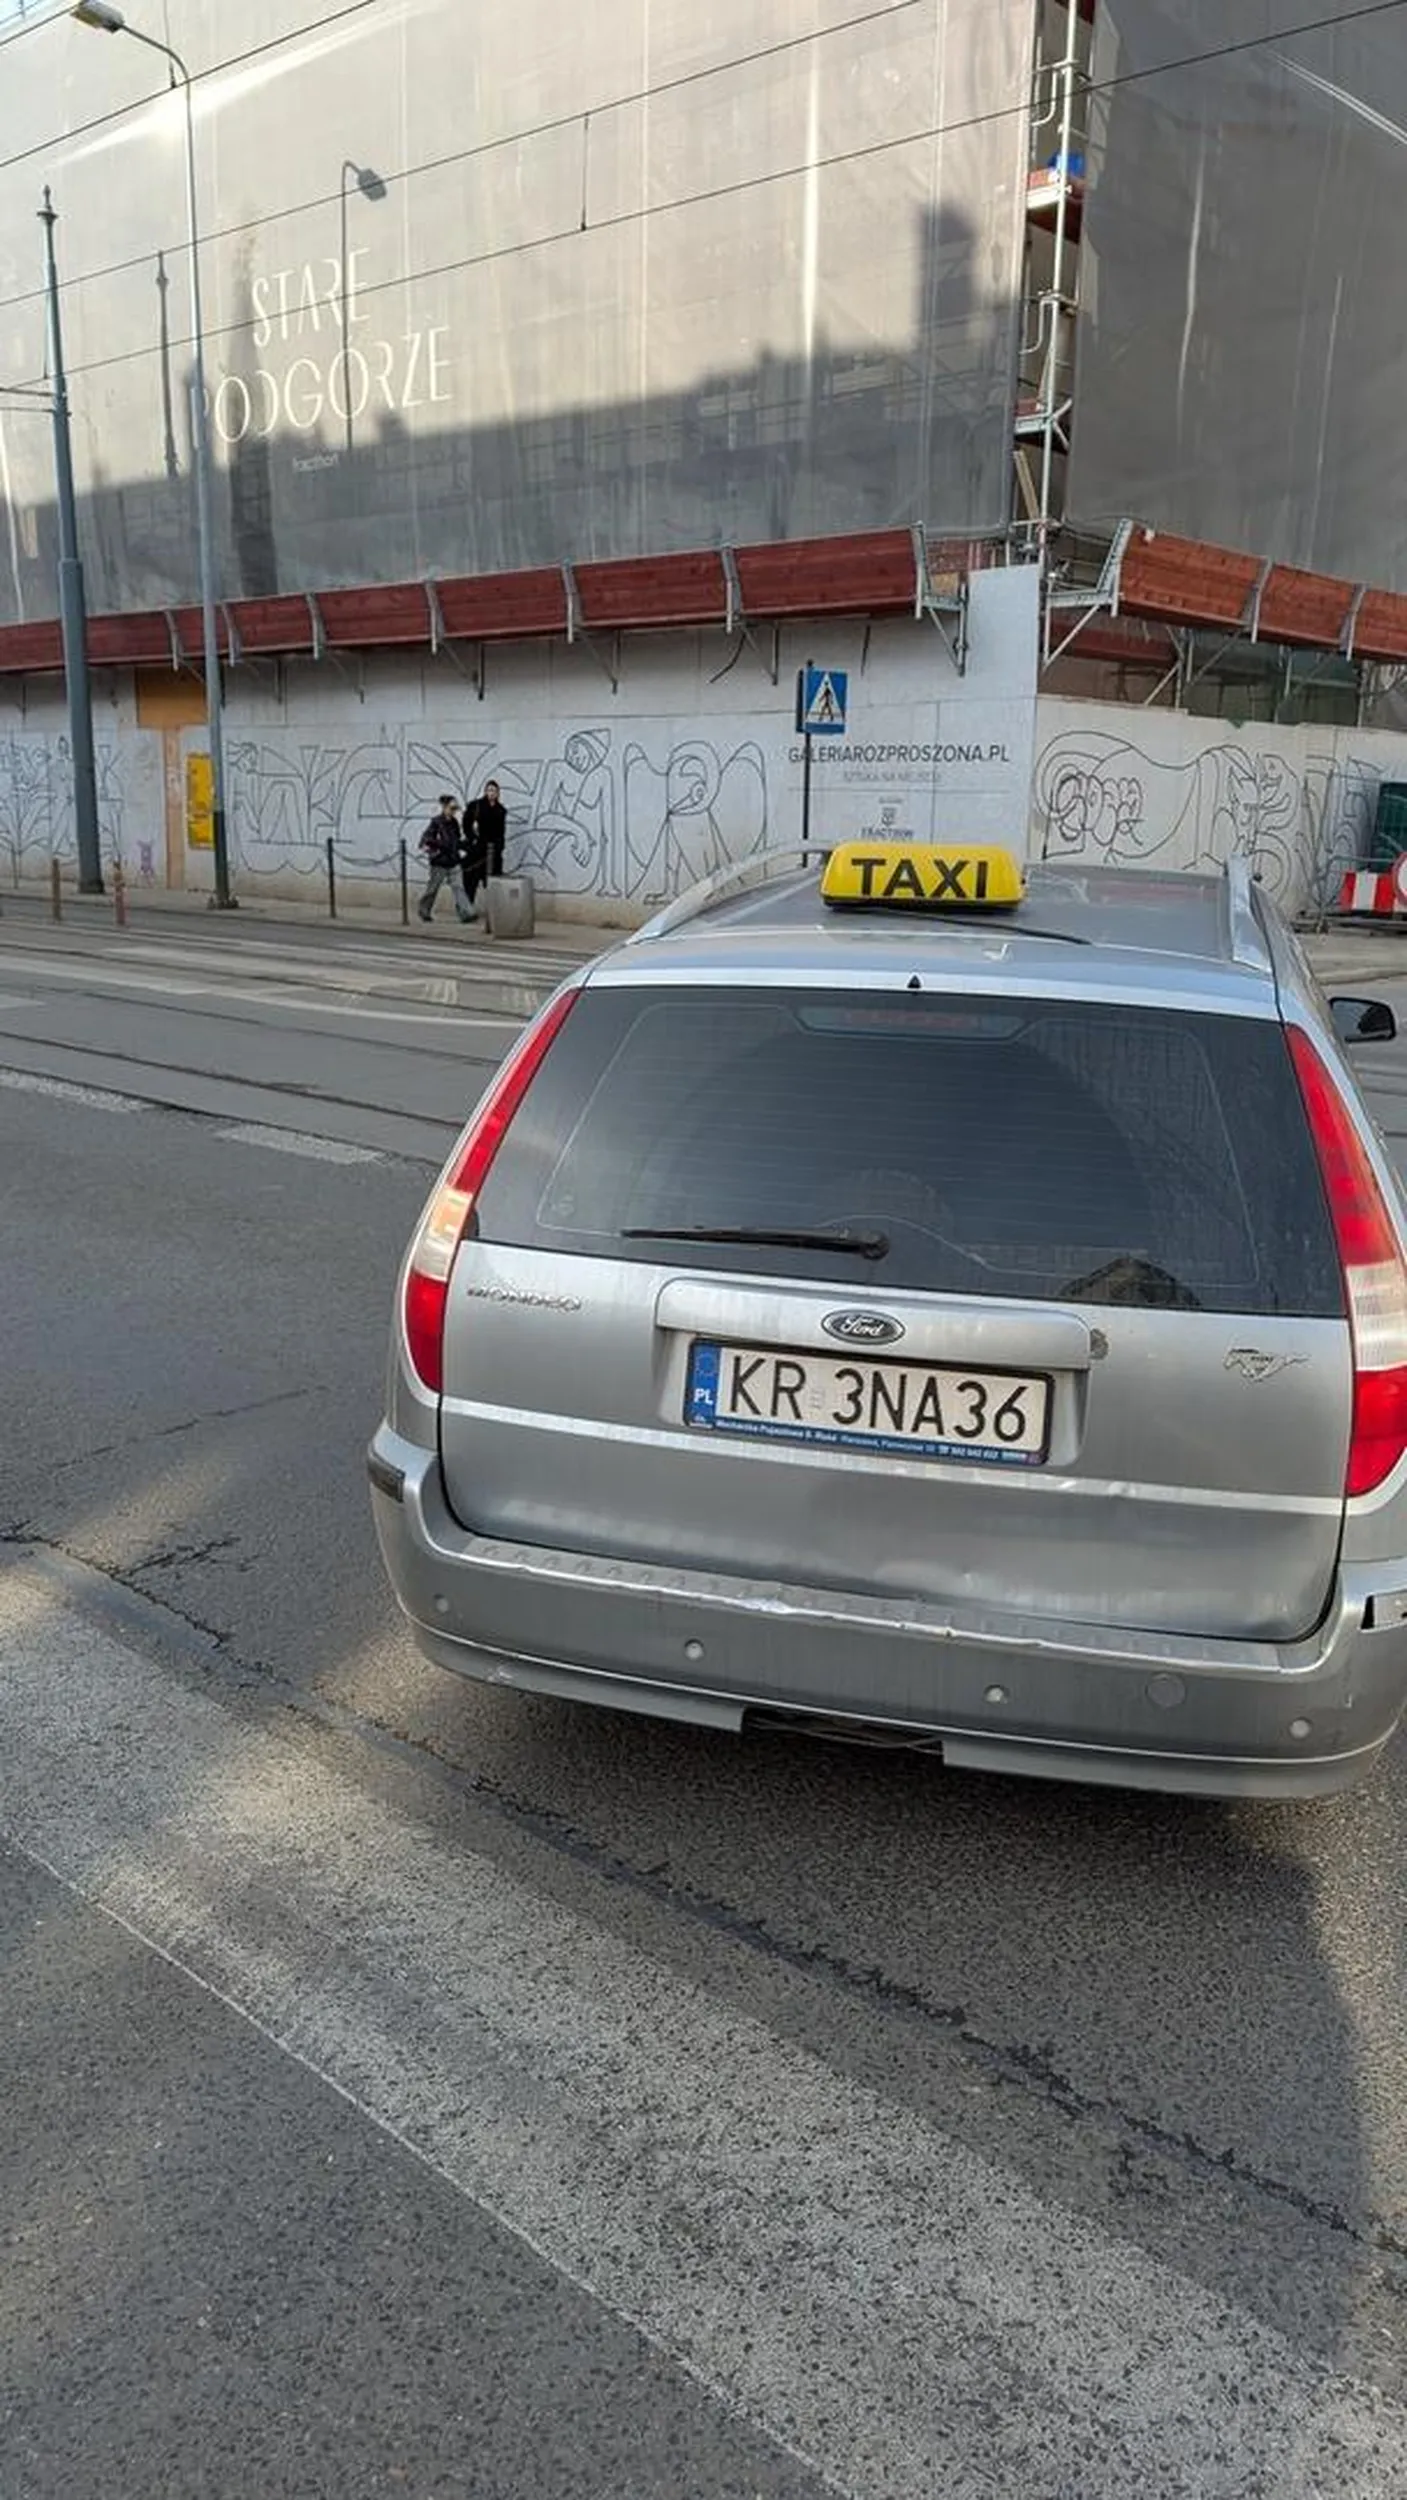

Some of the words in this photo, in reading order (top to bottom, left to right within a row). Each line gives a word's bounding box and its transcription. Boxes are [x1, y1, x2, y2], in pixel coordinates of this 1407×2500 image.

[252, 247, 370, 348] STARE
[851, 858, 988, 899] TAXI
[841, 1316, 885, 1336] Ford
[694, 1388, 714, 1405] PL
[730, 1355, 806, 1420] KR
[832, 1368, 1029, 1442] 3NA36
